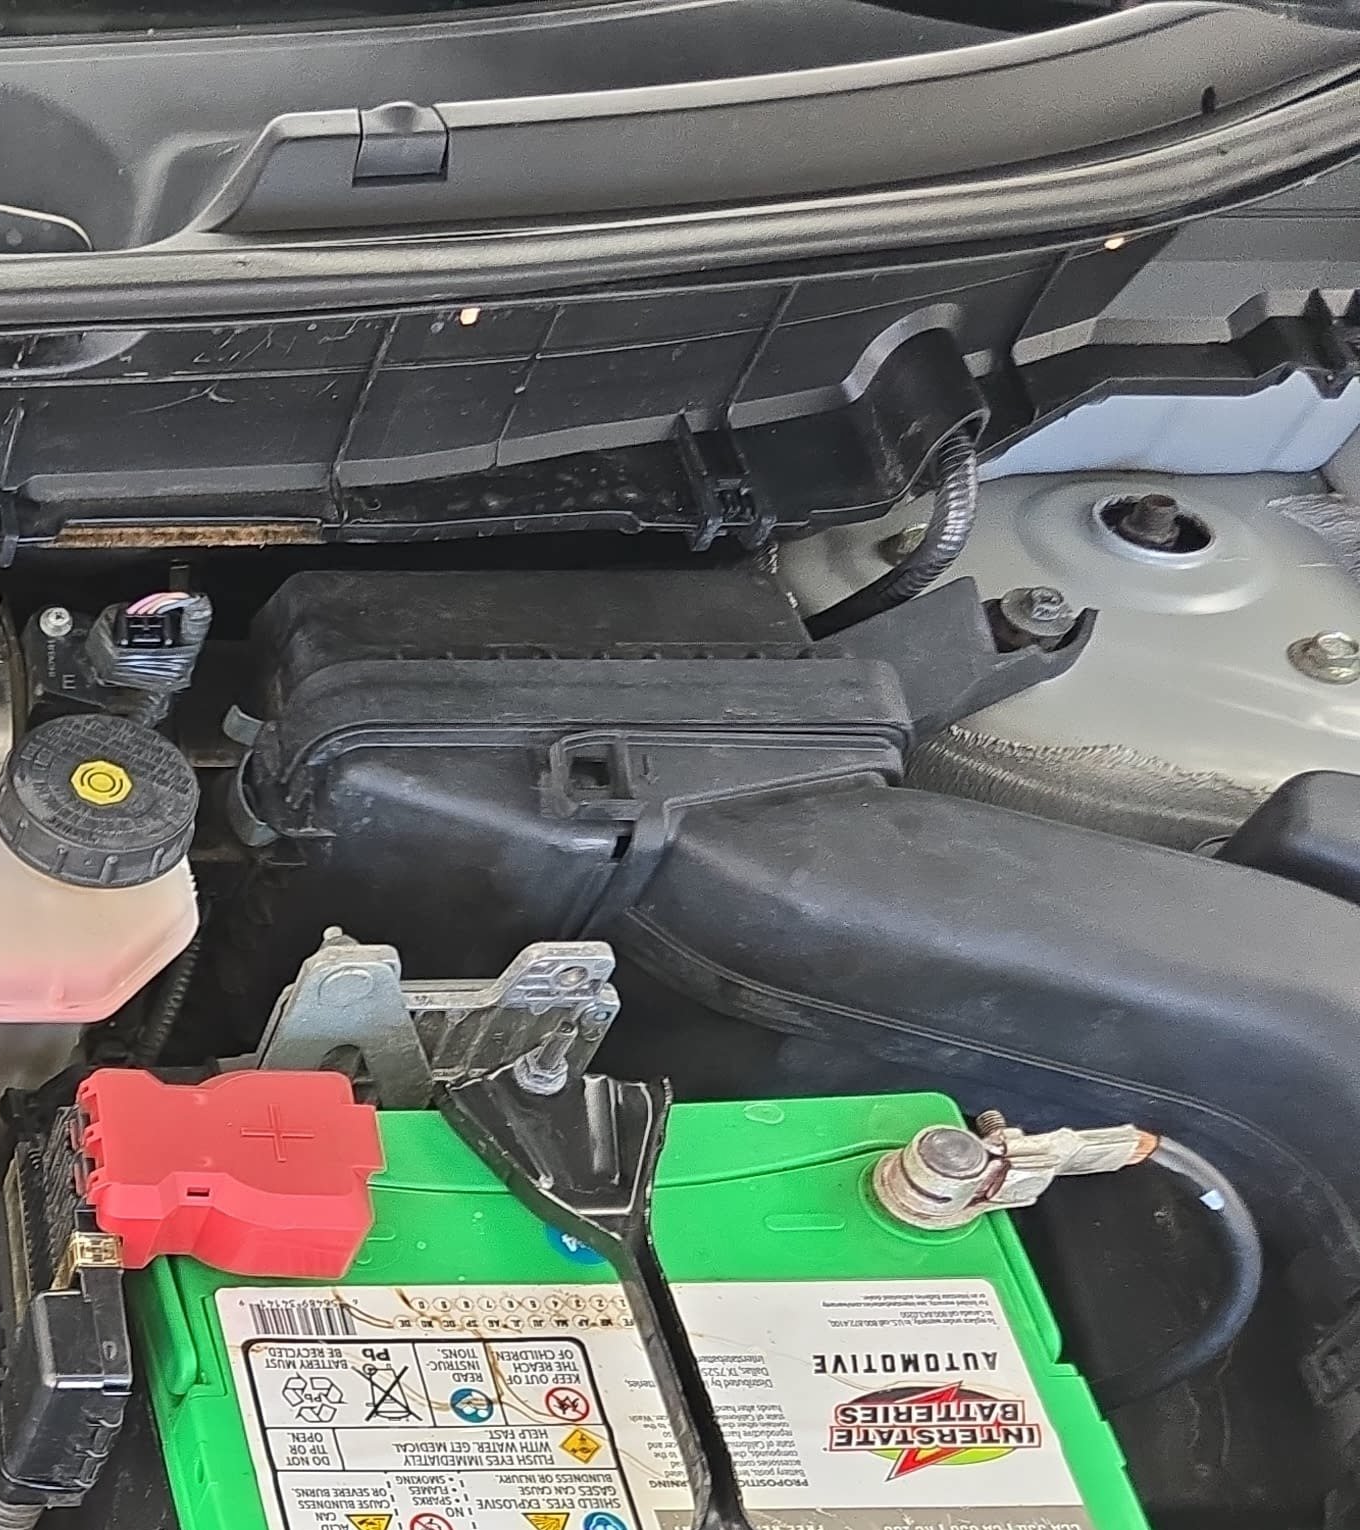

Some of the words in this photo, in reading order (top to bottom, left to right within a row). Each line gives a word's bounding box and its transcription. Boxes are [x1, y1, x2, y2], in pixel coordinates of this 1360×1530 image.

[264, 1347, 323, 1358] RECYCLED.
[326, 1348, 342, 1357] BE
[361, 1348, 390, 1361] Pb
[437, 1348, 478, 1358] TIONS.
[554, 1350, 574, 1360] OF
[264, 1359, 296, 1369] MUST
[299, 1359, 348, 1369] BATTERY
[425, 1360, 480, 1370] INSTRUC-
[513, 1362, 549, 1372] REACH
[553, 1361, 579, 1371] THE
[812, 1351, 998, 1374] AUTOMOTIVE
[452, 1372, 483, 1383] READ
[506, 1375, 520, 1385] OF
[523, 1374, 549, 1385] OUT
[552, 1374, 581, 1384] KEEP
[303, 1393, 322, 1401] Pb
[836, 1402, 1019, 1424] BATTERIES
[287, 1432, 323, 1442] OPEN.
[484, 1430, 515, 1440] FAST.
[518, 1429, 547, 1439] HELP
[834, 1427, 1036, 1447] INTERSTATE
[288, 1445, 307, 1454] OR
[309, 1445, 326, 1454] TIP
[392, 1442, 446, 1453] MEDICAL
[448, 1443, 471, 1452] GET
[472, 1442, 516, 1452] WATER.
[517, 1441, 552, 1452] WITH
[285, 1456, 309, 1466] NOT
[312, 1456, 330, 1465] DO
[403, 1455, 482, 1466] IMMEDIATELY
[486, 1455, 514, 1466] EYES
[517, 1454, 554, 1465] FLUSH
[395, 1475, 445, 1484] SMOKING
[495, 1474, 535, 1483] INJURY.
[538, 1474, 553, 1483] OR
[555, 1474, 612, 1483] BLINDNESS
[291, 1488, 329, 1498] BURNS.
[331, 1488, 369, 1497] SEVERE
[371, 1488, 387, 1497] OR
[409, 1486, 449, 1495] FLAMES
[519, 1486, 552, 1496] CAUSE
[554, 1486, 576, 1495] CAN
[578, 1486, 616, 1495] GASES
[298, 1500, 355, 1509] BLINDNESS
[357, 1499, 390, 1509] CAUSE
[412, 1496, 452, 1506] SPARKS
[476, 1499, 540, 1510] EXPLOSIVE
[542, 1498, 574, 1509] EYES.
[578, 1498, 621, 1509] SHIELD
[315, 1512, 336, 1521] CAN
[445, 1507, 464, 1517] NO
